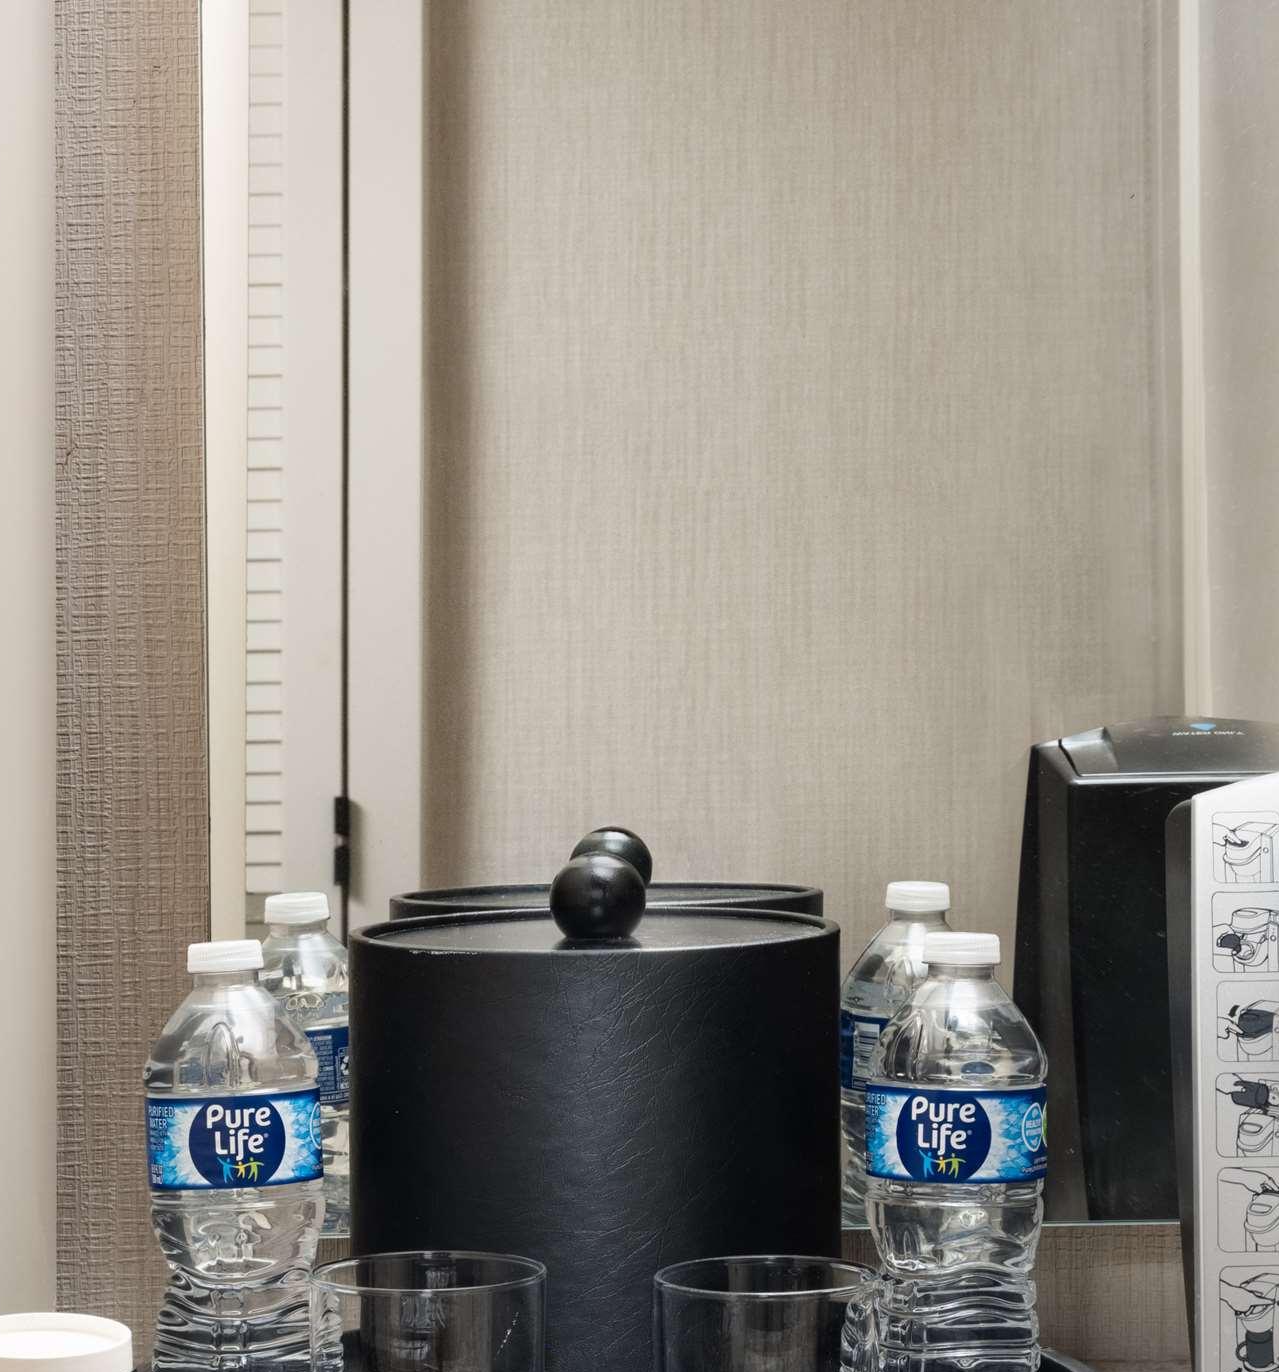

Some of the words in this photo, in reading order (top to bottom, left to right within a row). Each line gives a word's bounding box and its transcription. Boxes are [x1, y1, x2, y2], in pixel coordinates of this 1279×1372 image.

[206, 1104, 271, 1129] Pure
[911, 1096, 976, 1123] Pure
[214, 1128, 265, 1161] Life
[918, 1122, 967, 1155] Life
